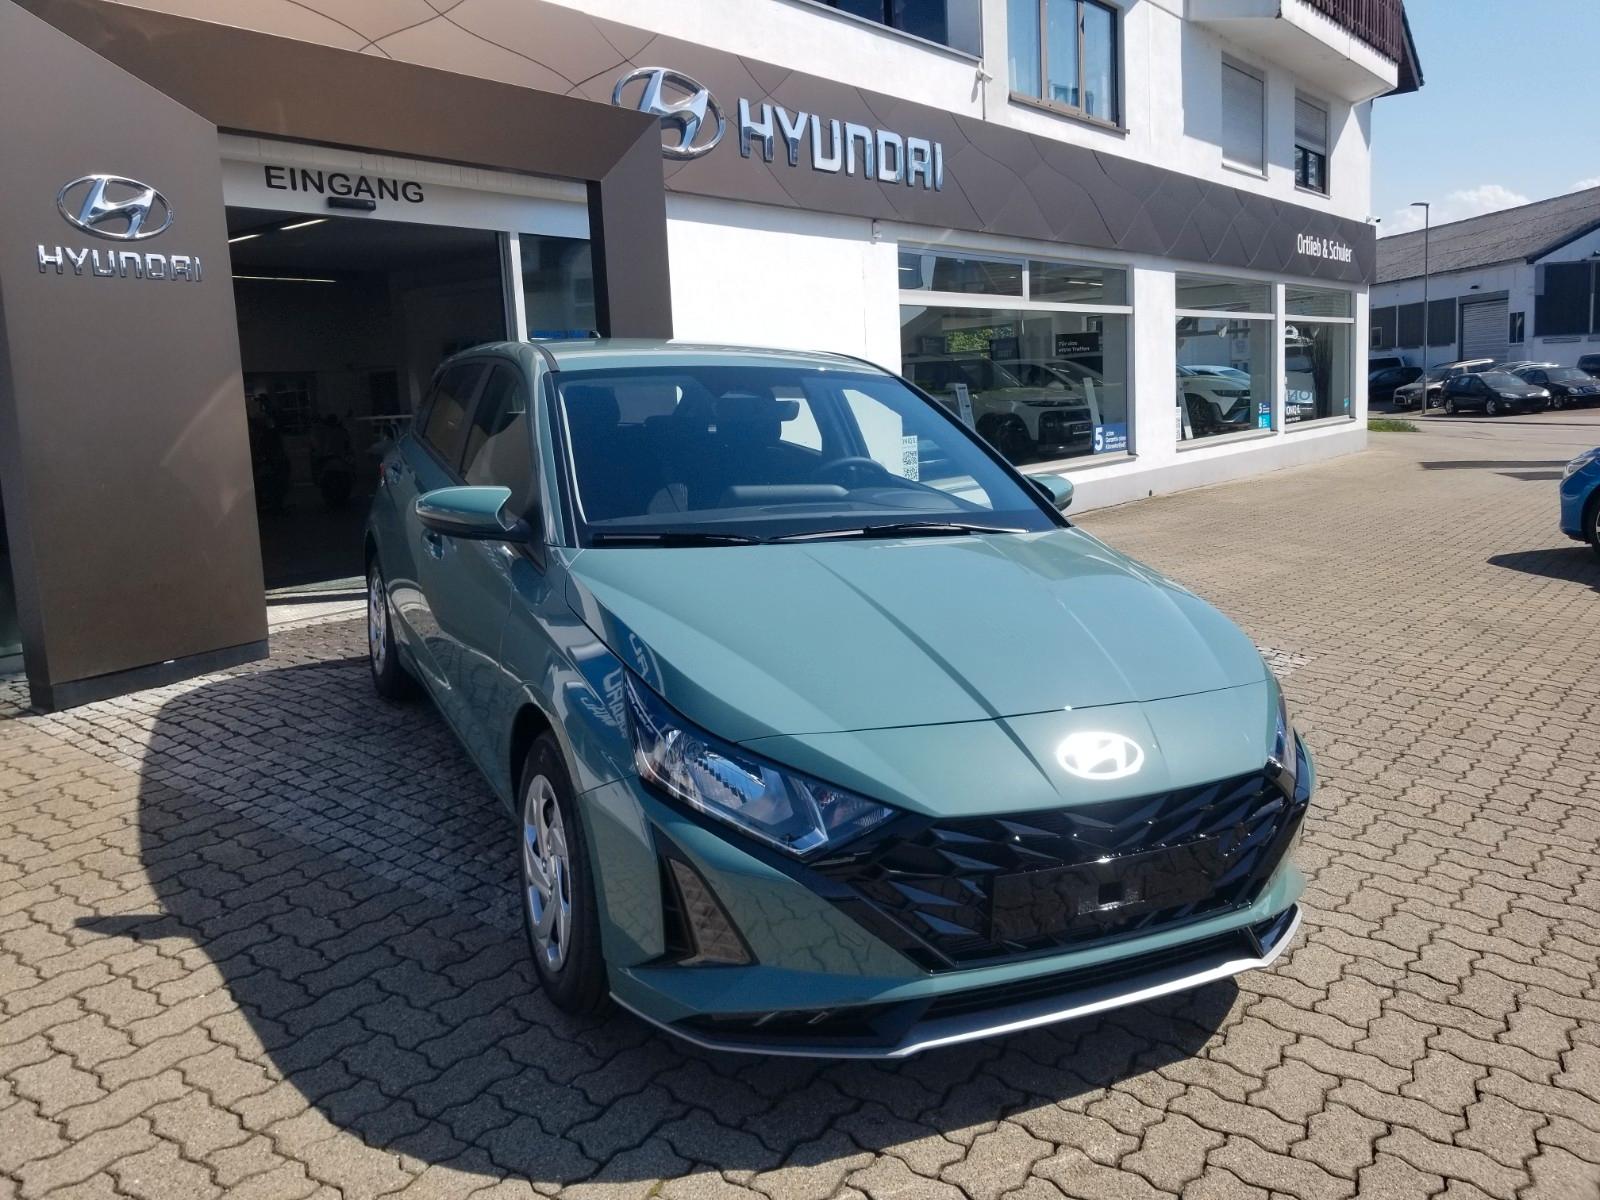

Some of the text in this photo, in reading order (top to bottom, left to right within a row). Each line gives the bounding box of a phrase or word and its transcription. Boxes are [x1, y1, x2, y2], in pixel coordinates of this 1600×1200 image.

[738, 97, 943, 192] HYUNDAI
[264, 165, 425, 203] EINGANG
[37, 244, 202, 282] HYUNDAI
[1297, 233, 1352, 262] Ortlieb & Schuler
[1095, 426, 1103, 451] 5
